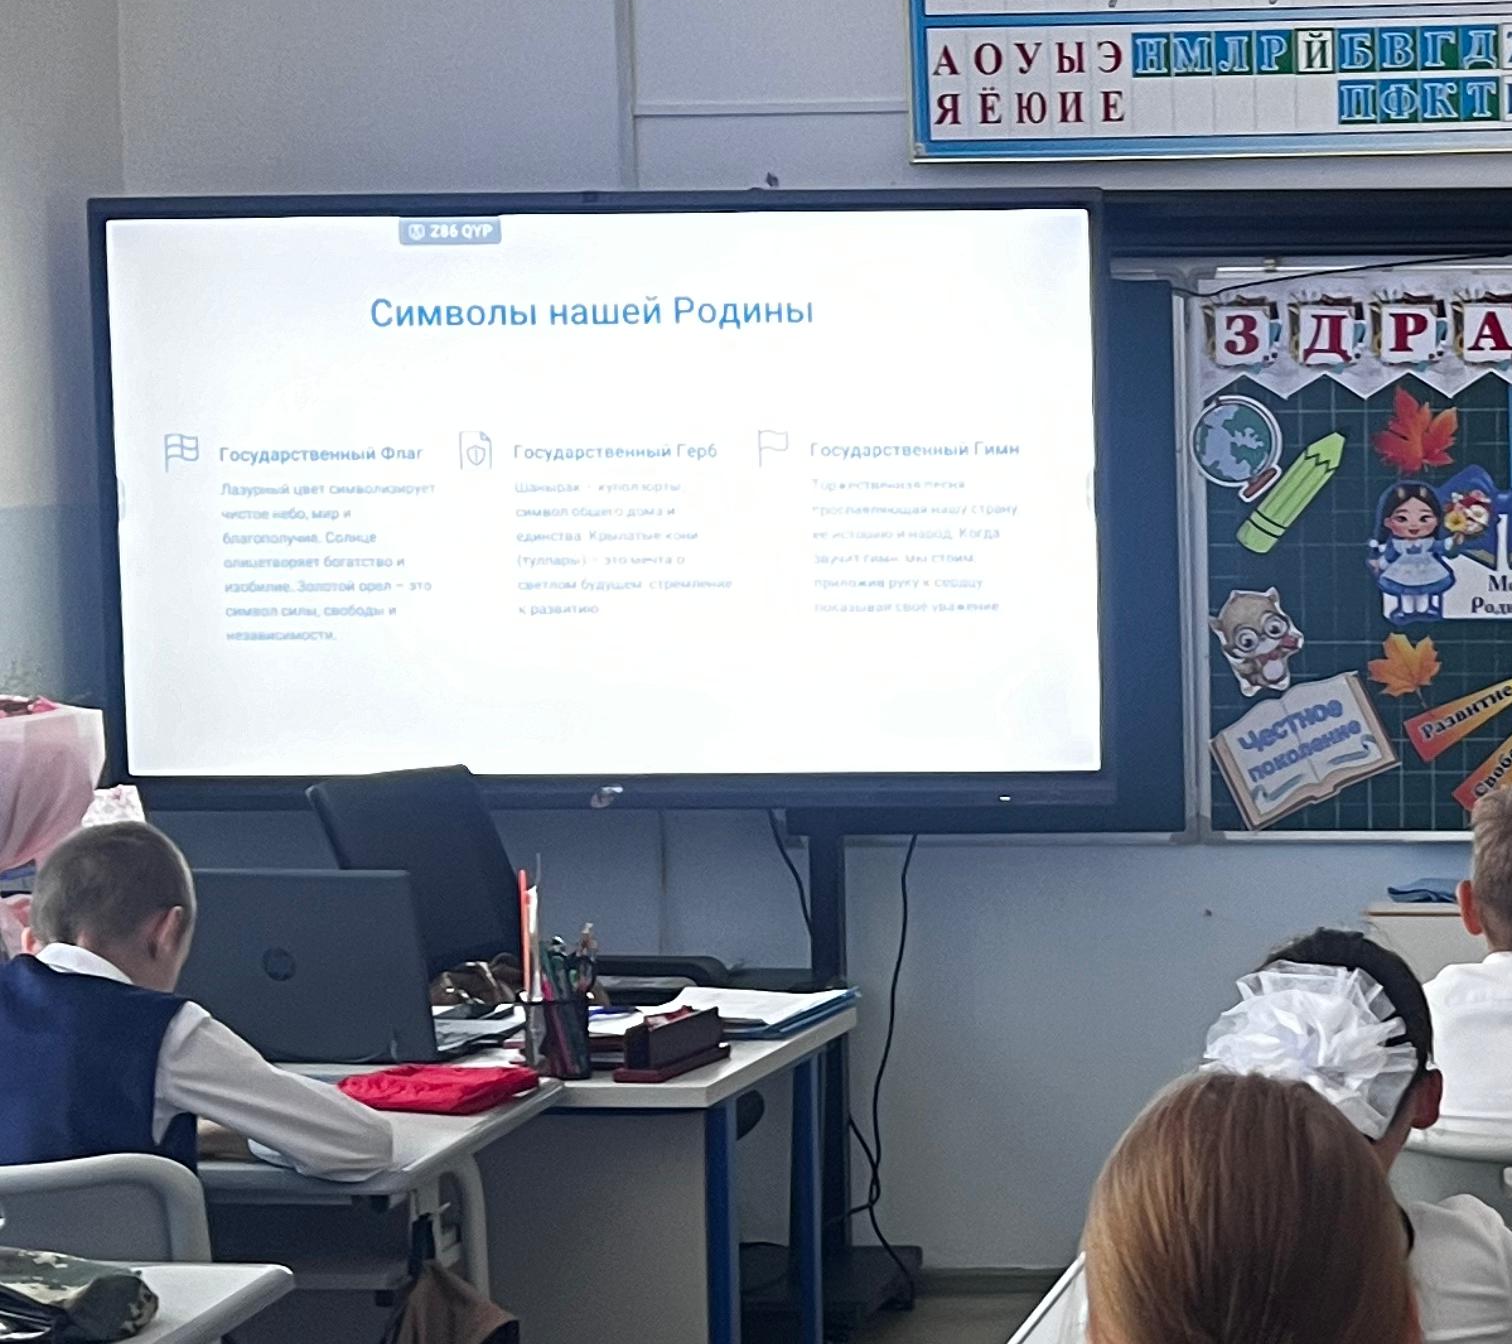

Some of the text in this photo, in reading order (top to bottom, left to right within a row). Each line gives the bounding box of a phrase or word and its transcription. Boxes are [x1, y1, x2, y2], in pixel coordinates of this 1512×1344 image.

[933, 45, 959, 75] А
[974, 43, 1002, 74] О
[1014, 43, 1042, 73] У
[1056, 42, 1084, 73] Ы
[1098, 41, 1123, 72] Э
[1136, 38, 1168, 73] Н
[1173, 37, 1210, 72] М
[1219, 36, 1248, 72] Л
[1260, 36, 1287, 70] Р
[1305, 32, 1328, 69] Й
[1341, 34, 1373, 69] Б
[1382, 33, 1414, 68] В
[1424, 31, 1456, 67] Г
[1463, 30, 1497, 69] Д
[934, 94, 961, 124] Я
[979, 87, 1001, 123] Ё
[1016, 92, 1047, 123] Ю
[1058, 92, 1083, 122] И
[1102, 91, 1124, 121] Е
[1340, 84, 1376, 119] П
[1380, 84, 1418, 118] Ф
[1424, 84, 1458, 118] К
[1468, 82, 1496, 116] Т
[462, 224, 493, 238] QYP
[371, 296, 814, 328] Символы нашей Родины
[220, 446, 423, 465] Государственный Флаг
[514, 444, 717, 462] Государственный Герб
[811, 441, 1020, 460] Государственный Гимн
[221, 483, 324, 497] Лазурный цвет
[326, 532, 376, 543] Солнце
